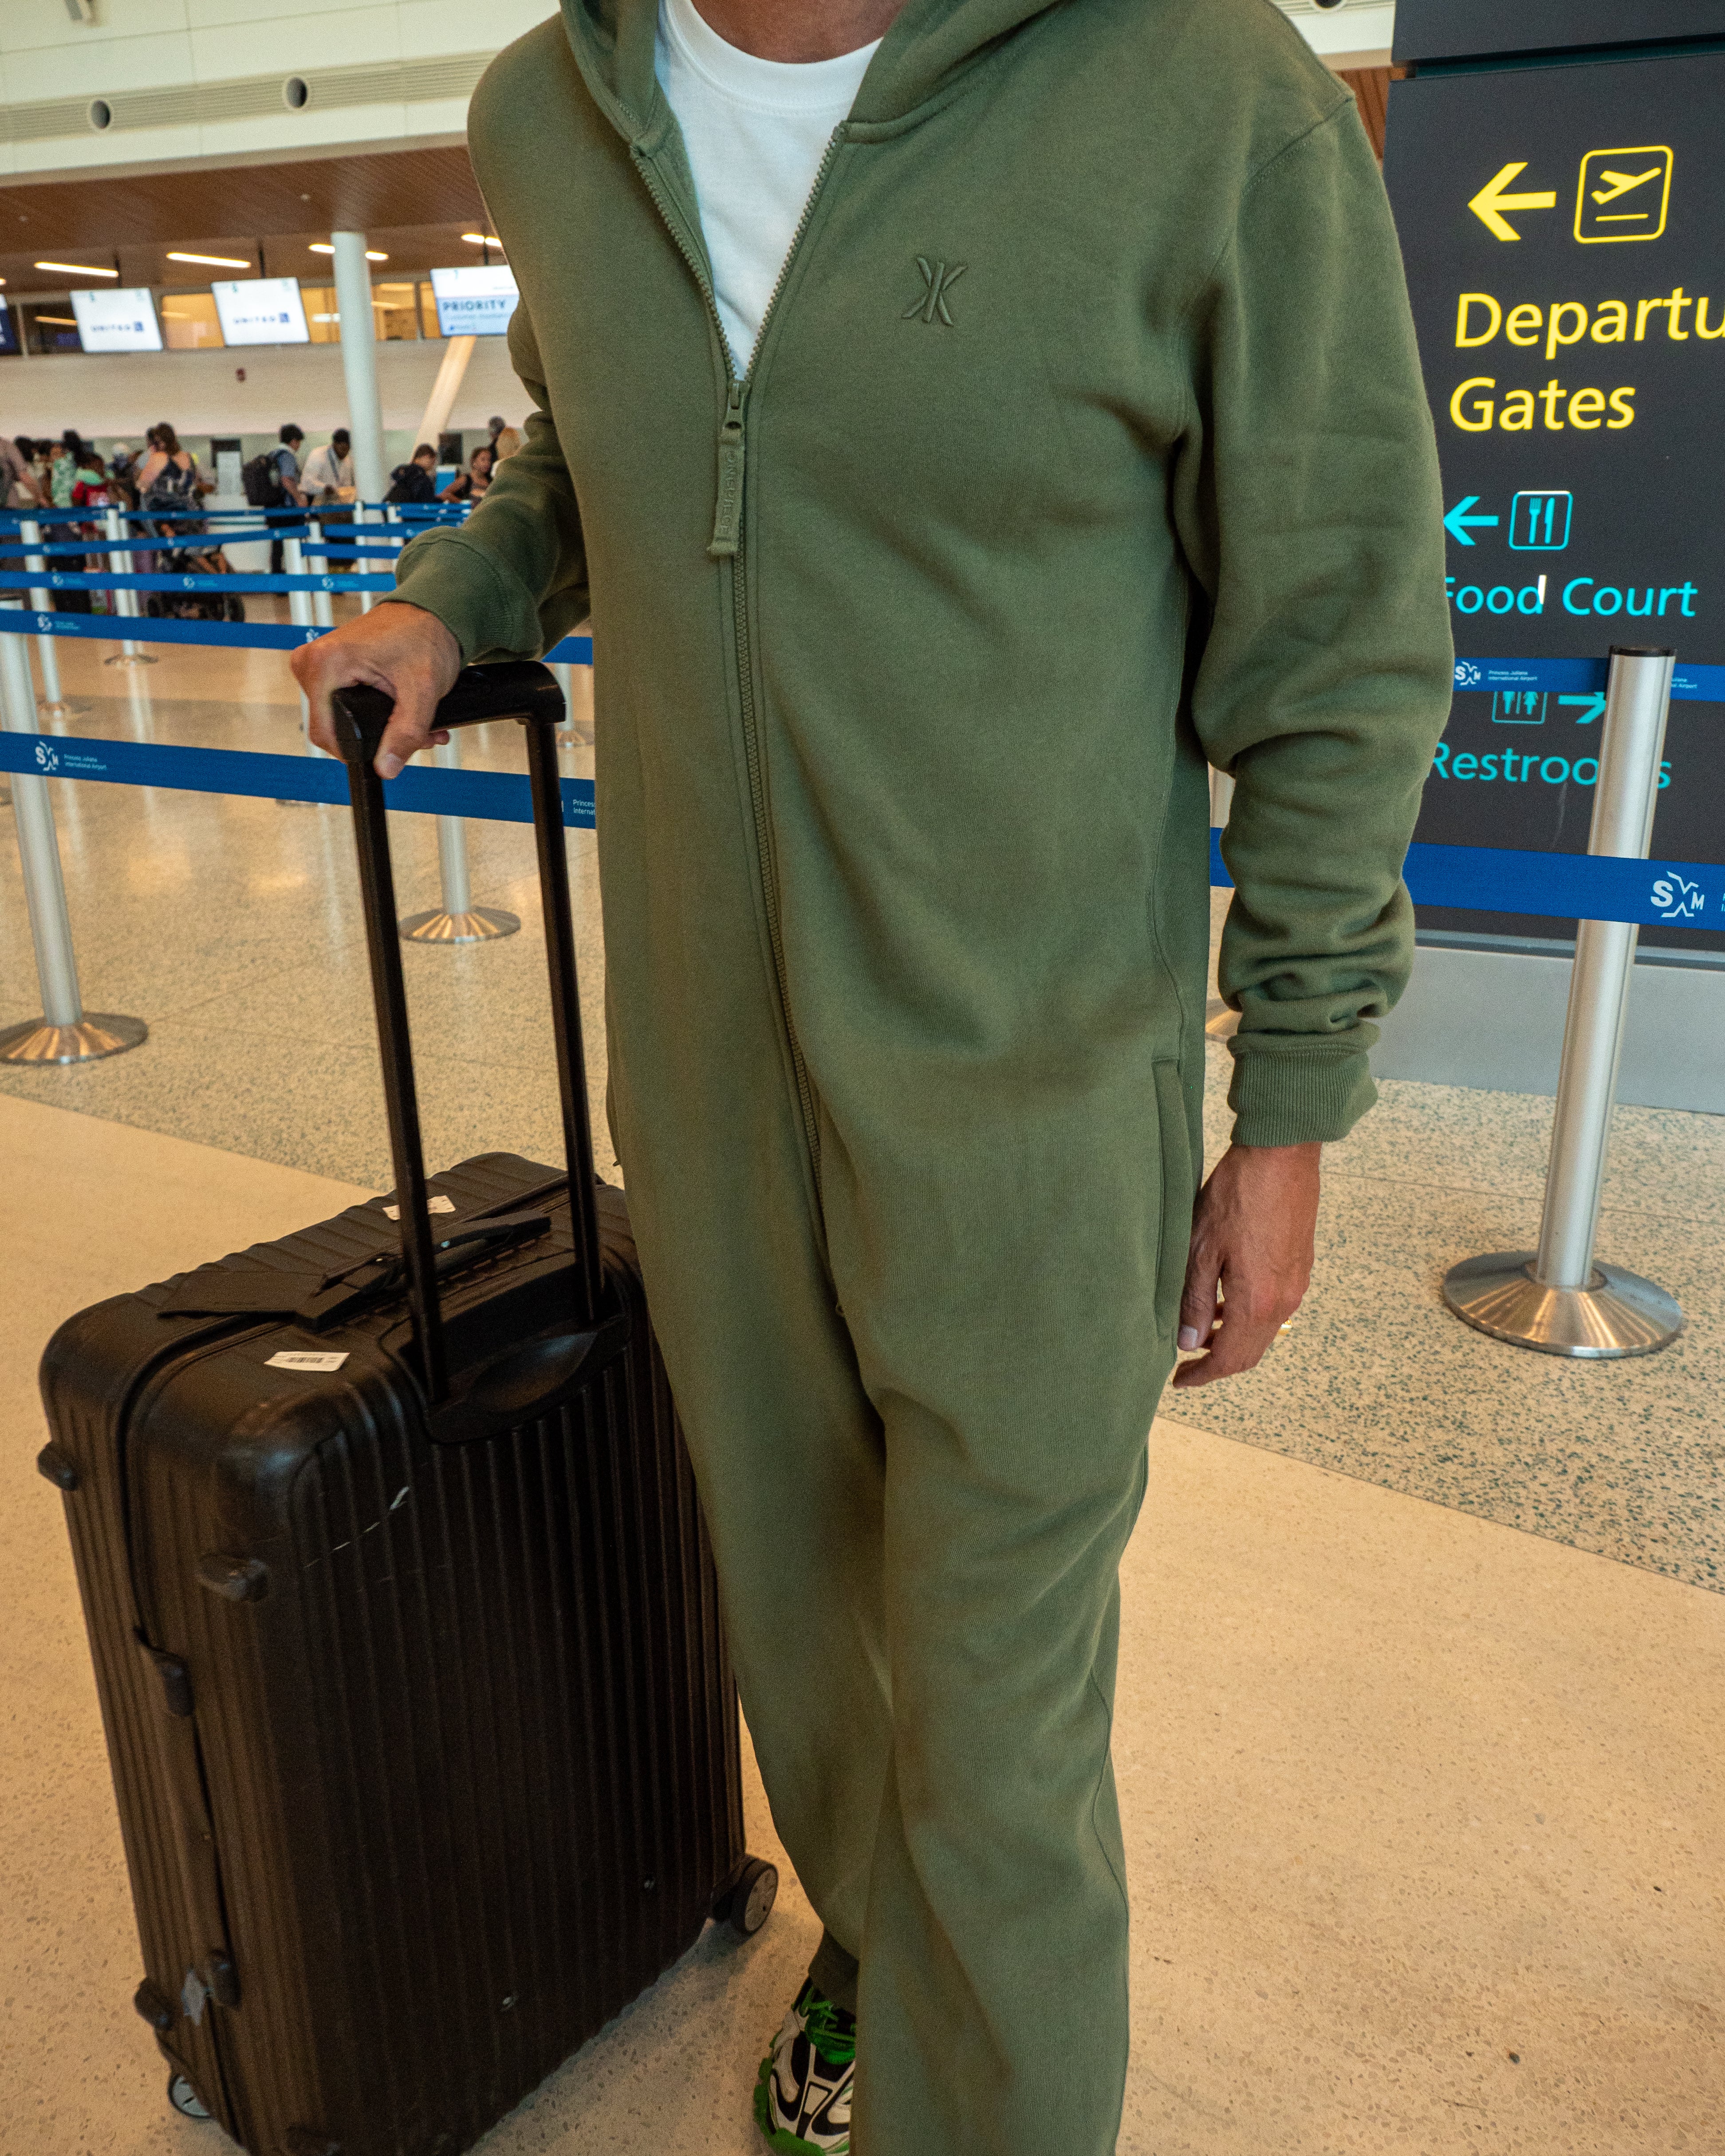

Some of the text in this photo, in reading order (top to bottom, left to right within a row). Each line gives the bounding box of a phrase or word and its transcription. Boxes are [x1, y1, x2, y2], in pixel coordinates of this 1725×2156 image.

[443, 299, 505, 311] PRIORITY
[1455, 287, 1725, 360] Departu
[1450, 377, 1635, 432] Gates
[1562, 577, 1698, 617] Court
[1427, 742, 1671, 789] Restroos
